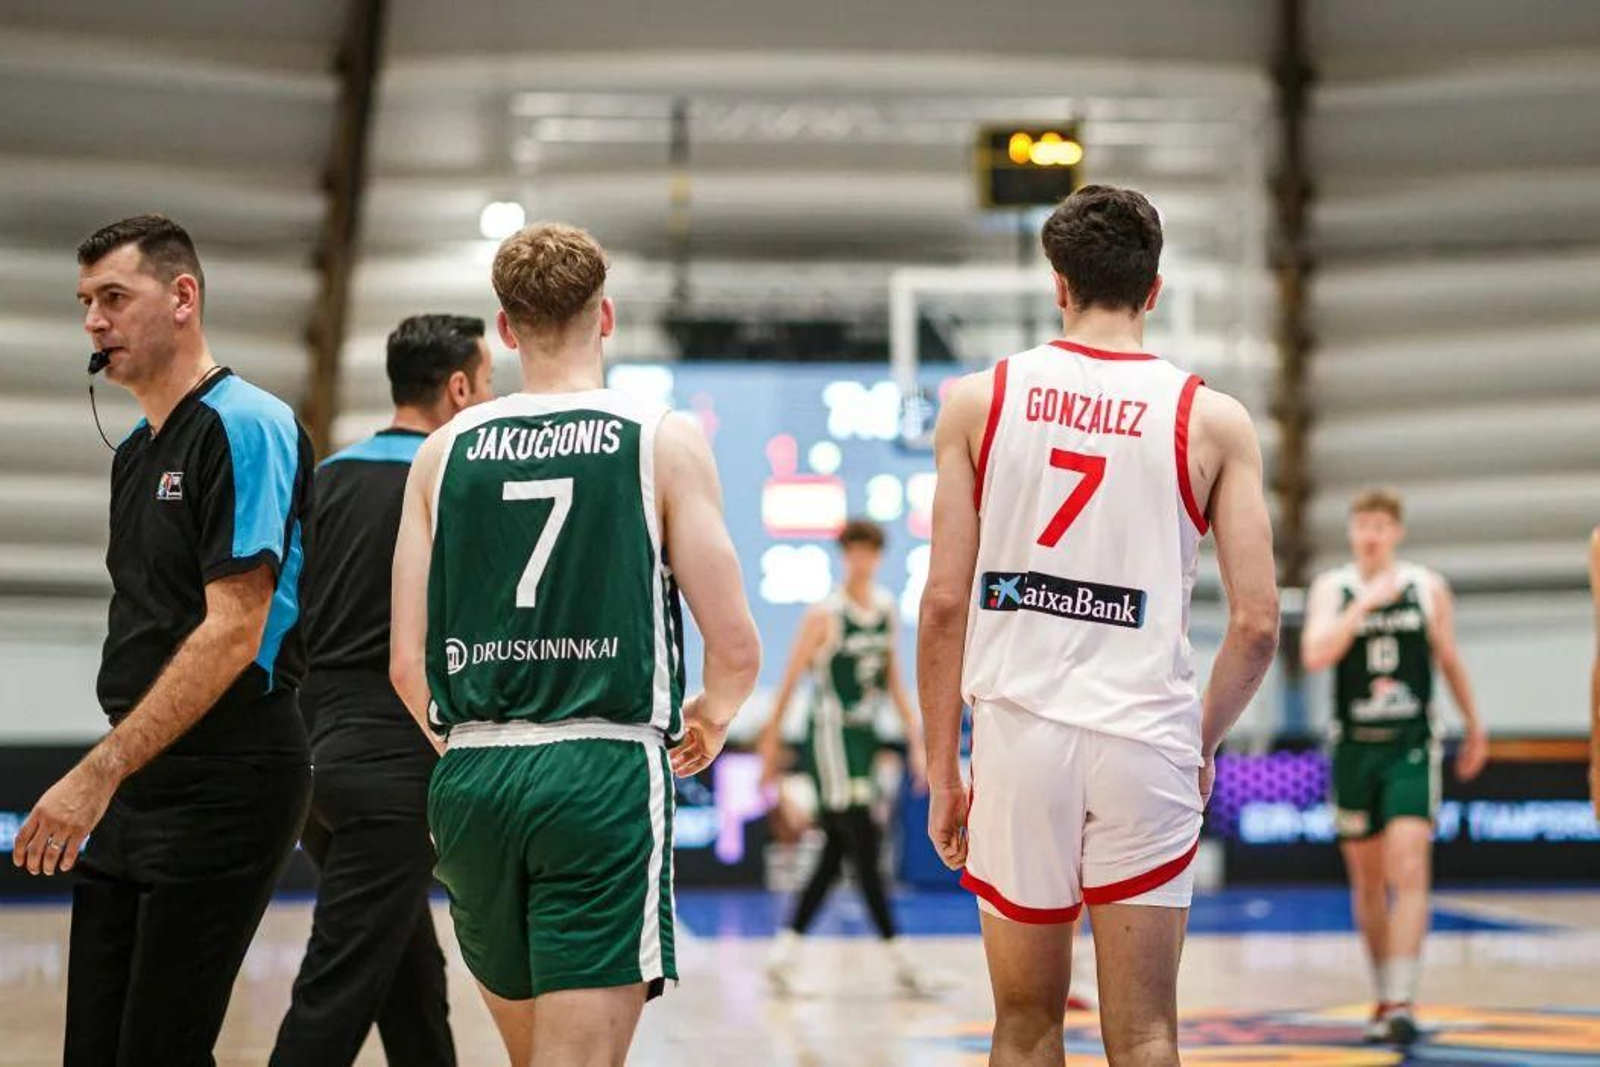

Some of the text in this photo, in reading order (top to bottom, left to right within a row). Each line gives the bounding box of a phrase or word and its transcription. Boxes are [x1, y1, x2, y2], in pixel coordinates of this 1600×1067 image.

[1026, 387, 1148, 437] GONZÁLEZ
[466, 420, 622, 461] JAKUČIONIS
[1036, 447, 1107, 548] 7
[502, 477, 574, 608] 7
[1020, 577, 1137, 623] aixaBank
[472, 637, 619, 665] DRUSKININKAI
